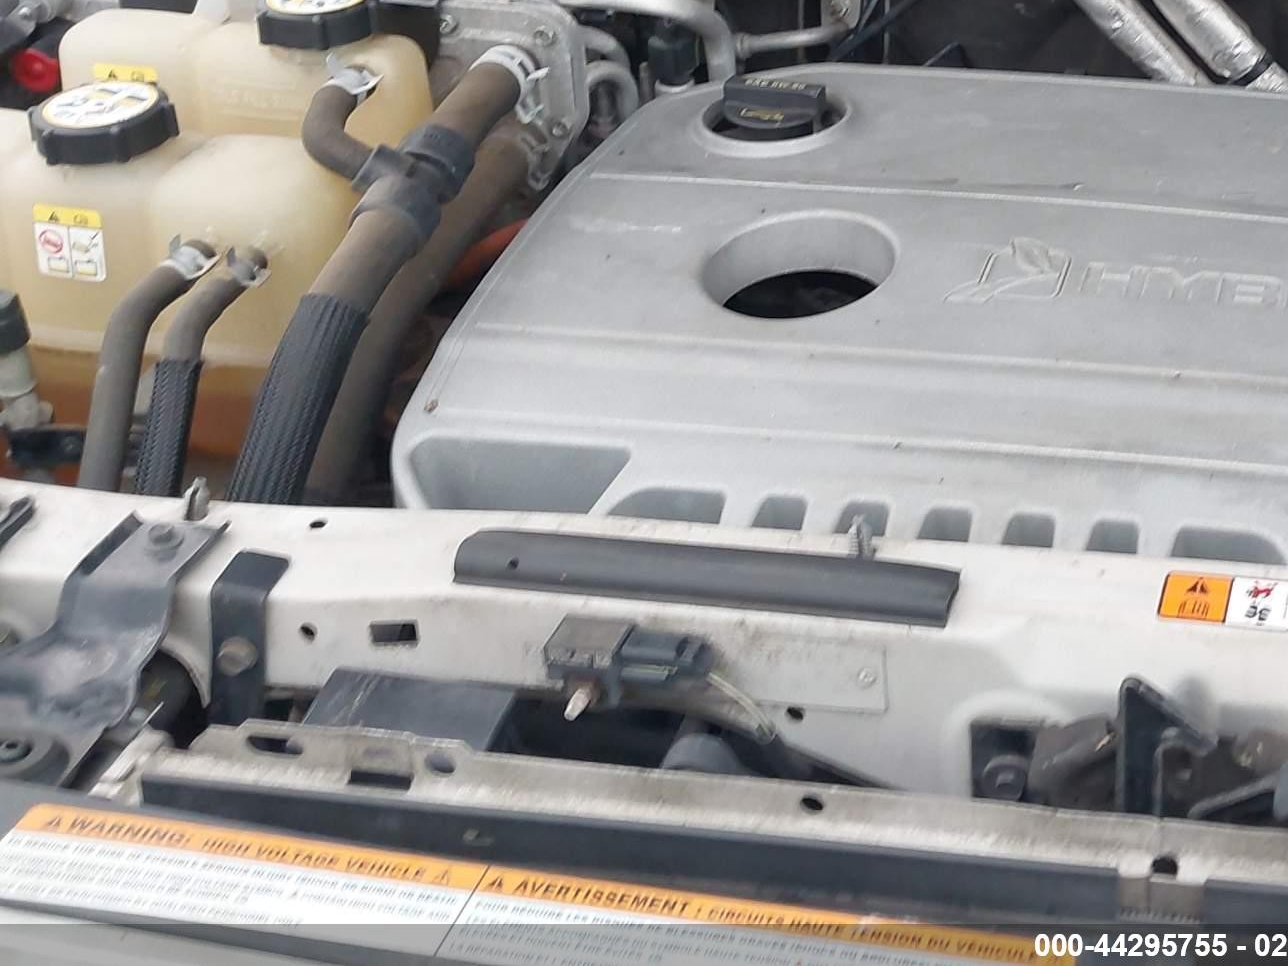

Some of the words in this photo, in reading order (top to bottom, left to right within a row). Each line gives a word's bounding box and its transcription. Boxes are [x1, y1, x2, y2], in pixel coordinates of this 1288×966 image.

[202, 838, 251, 857] HIGH
[255, 843, 340, 866] VOLTAGE
[345, 854, 426, 881] VEHICLE
[513, 877, 690, 915] AVERTISSEMENT
[850, 925, 923, 948] TENSION
